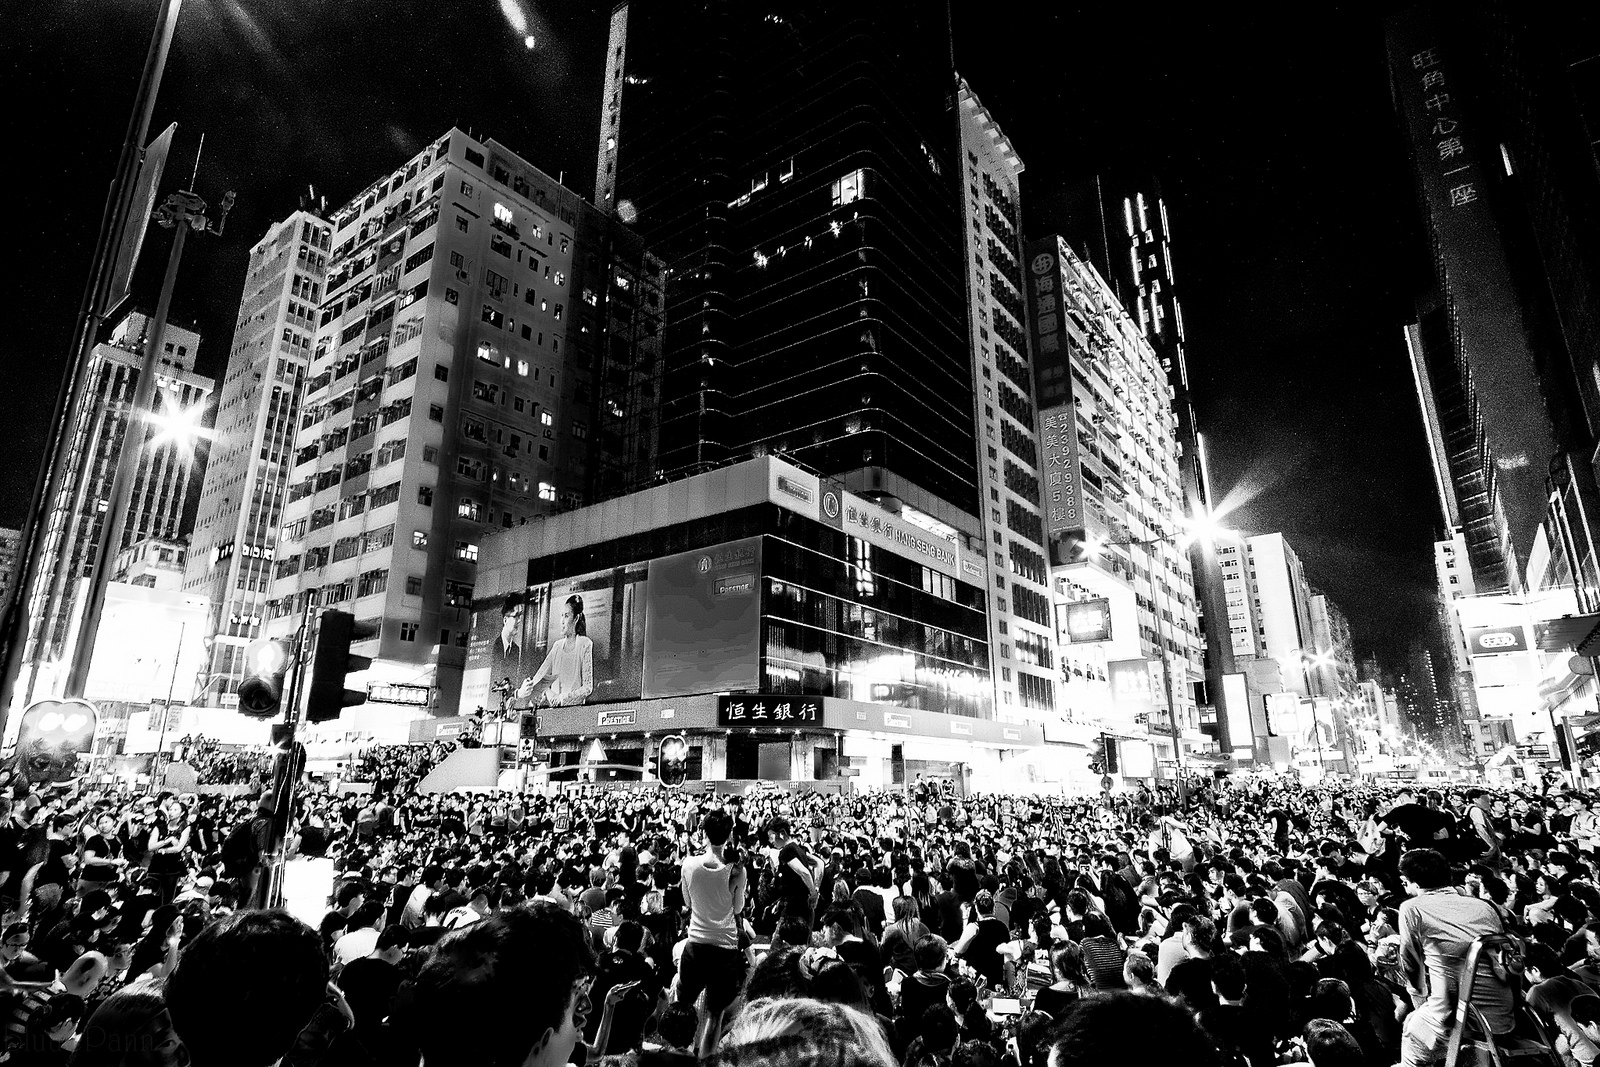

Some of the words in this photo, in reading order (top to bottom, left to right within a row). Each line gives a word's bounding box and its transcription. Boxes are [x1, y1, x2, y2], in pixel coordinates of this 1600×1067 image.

[1411, 47, 1478, 208] 旺角中心第一座
[895, 529, 916, 550] HANG
[916, 539, 937, 558] SENG
[936, 549, 956, 567] BANK
[726, 701, 818, 722] 恒生銀行
